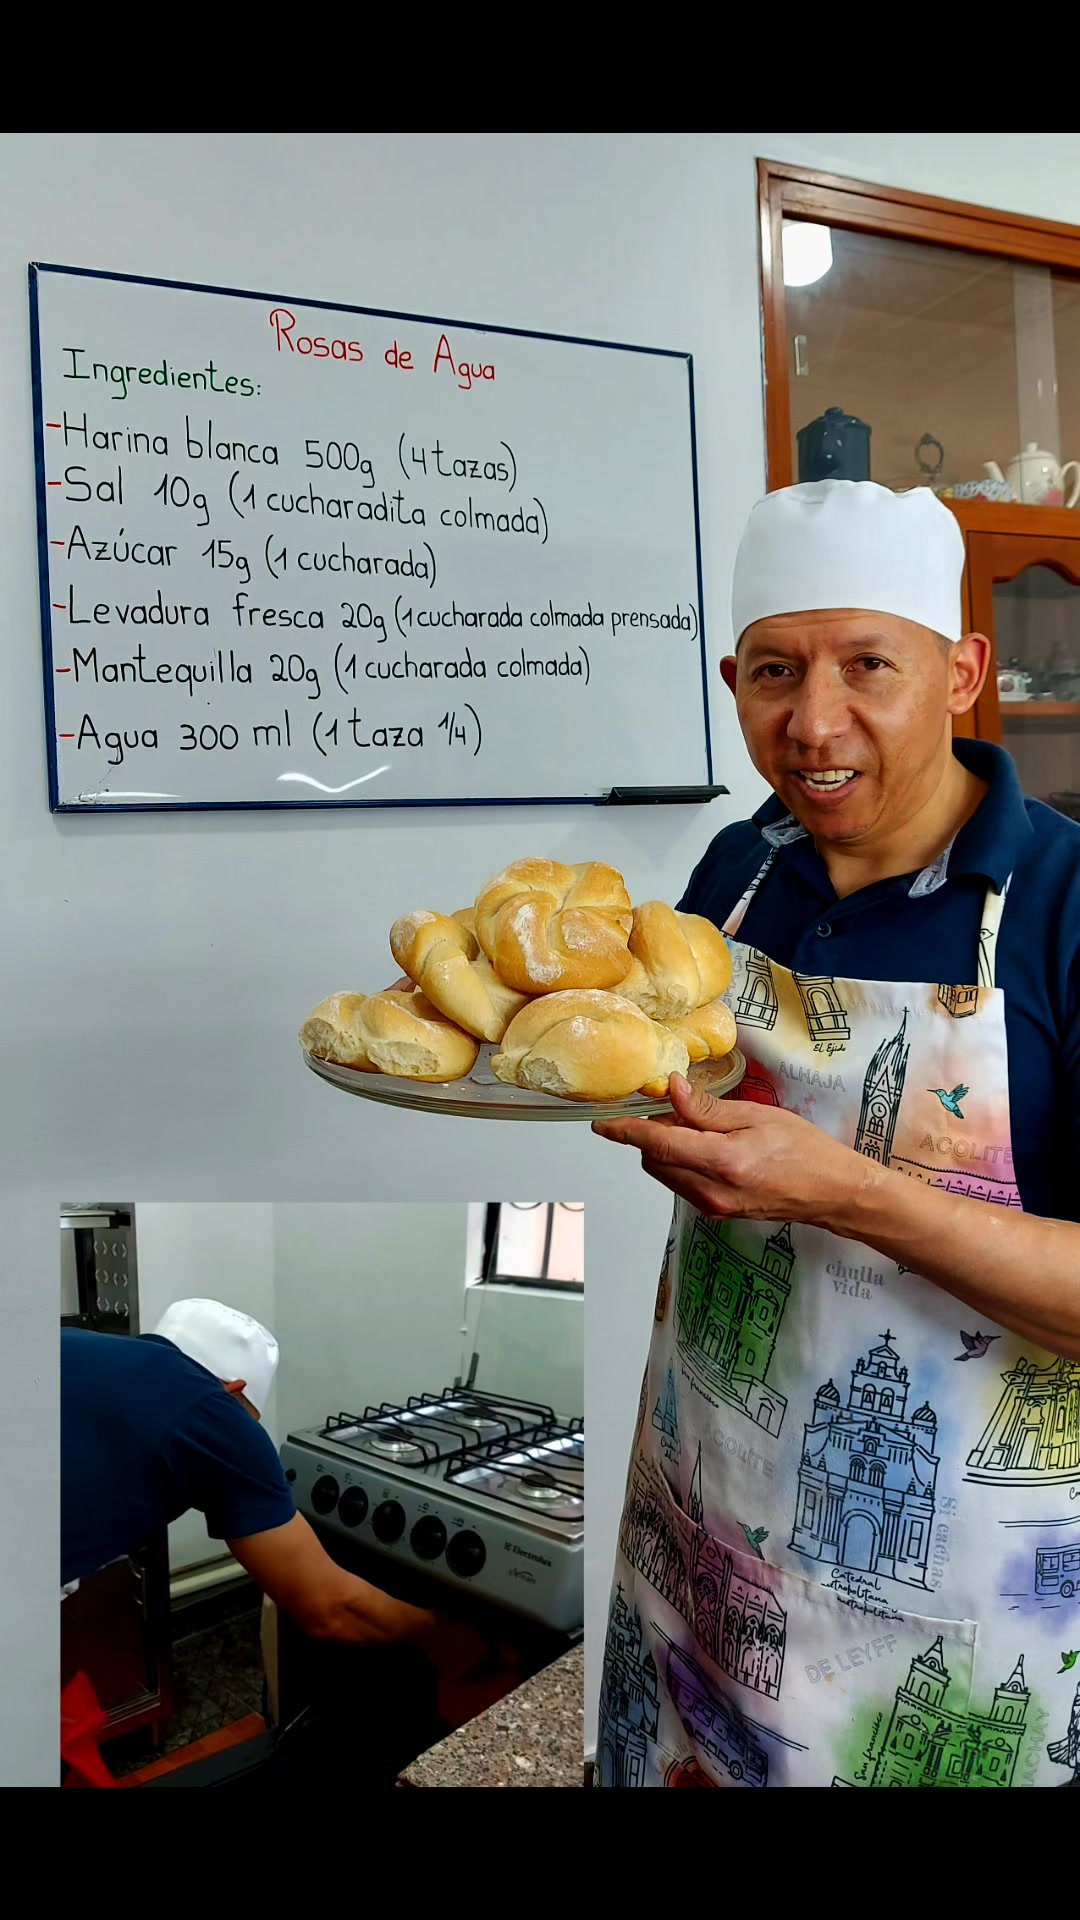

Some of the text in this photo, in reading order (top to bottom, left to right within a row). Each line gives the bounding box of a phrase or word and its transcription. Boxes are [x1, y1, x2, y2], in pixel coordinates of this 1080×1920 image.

[269, 308, 495, 390] Rosas de Agua
[61, 347, 262, 401] Ingredientes:
[185, 414, 279, 466] blanca
[304, 439, 376, 489] 500g
[153, 472, 211, 527] 10g
[266, 482, 426, 527] cucharadita
[439, 496, 549, 545] colmada)
[201, 538, 252, 585] 15g
[297, 541, 437, 589] cucharada)
[231, 591, 324, 629] fresca
[340, 601, 388, 644] 20g
[529, 599, 605, 628] colmada
[610, 602, 699, 642] prensada)
[269, 653, 322, 701] 20g
[364, 646, 487, 680] cucharada
[496, 645, 590, 686] colmada)
[179, 723, 239, 751] 300
[252, 708, 291, 747] ml
[346, 706, 424, 748] taza
[812, 1041, 847, 1057] El Ejido
[778, 1061, 847, 1092] ALHAJA
[918, 1133, 1013, 1165] ACOLITE
[825, 1260, 885, 1287] chulla
[832, 1278, 872, 1300] vida
[830, 1567, 882, 1591] Catedral
[805, 1658, 835, 1684] DE
